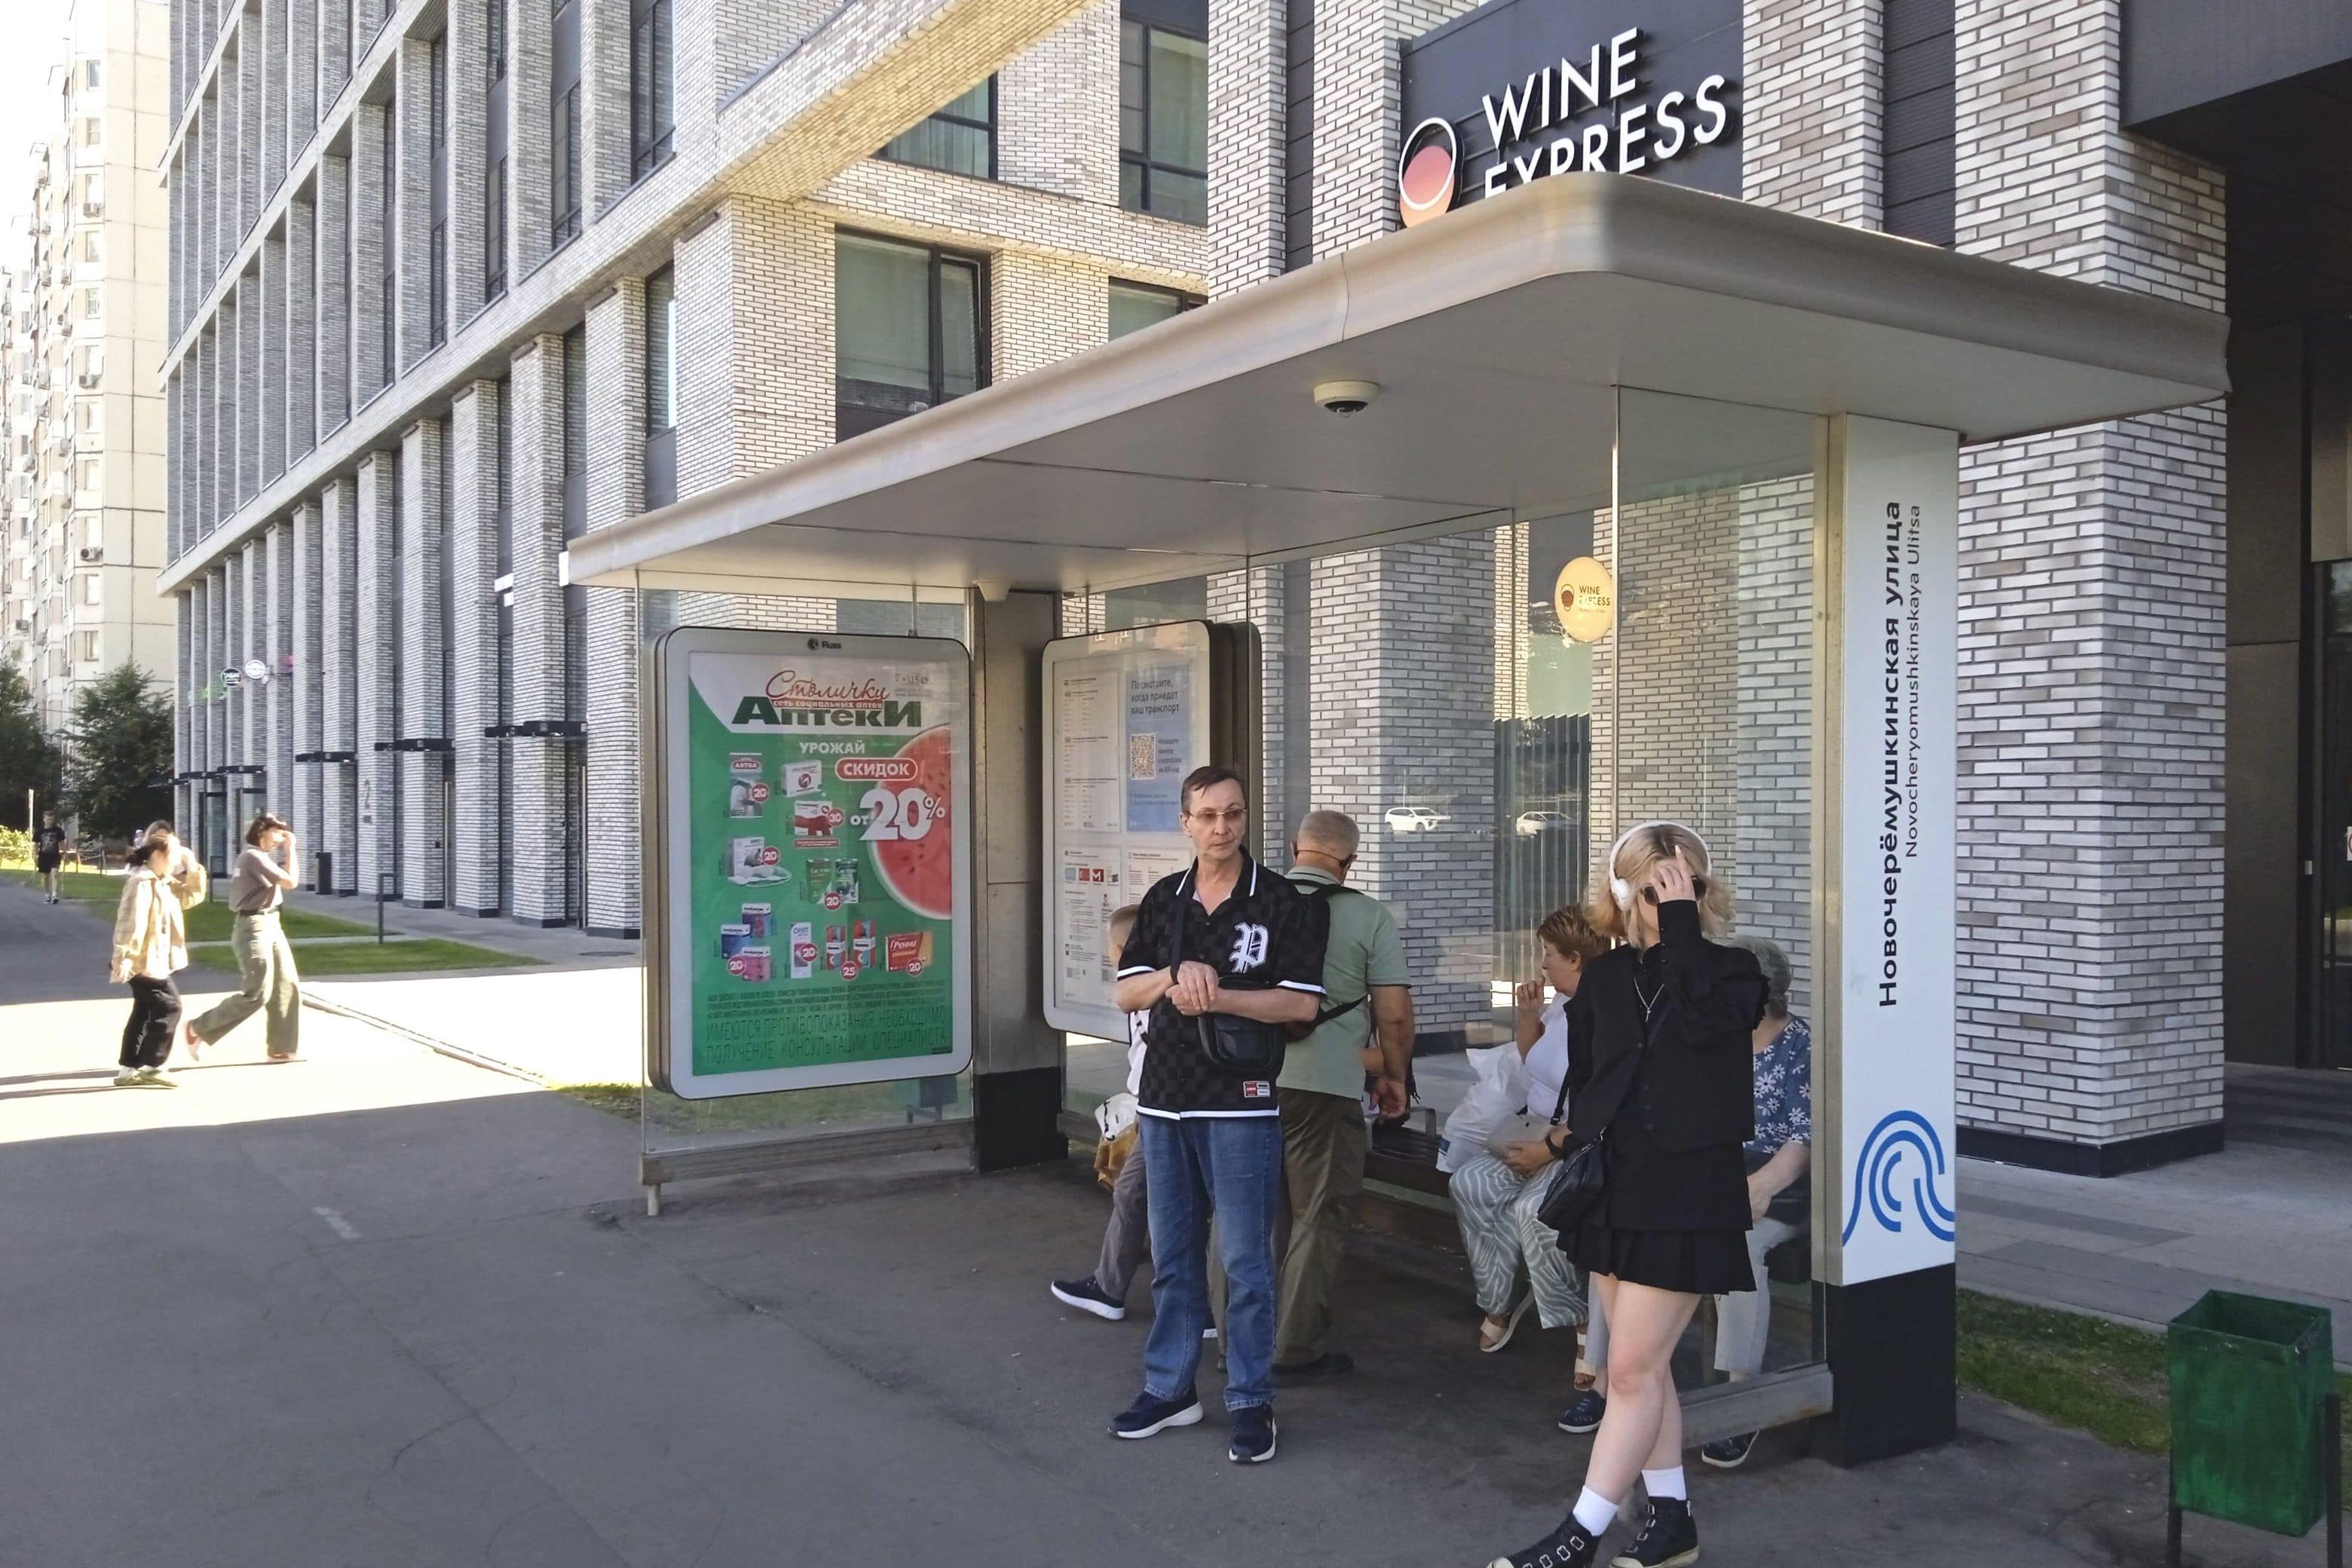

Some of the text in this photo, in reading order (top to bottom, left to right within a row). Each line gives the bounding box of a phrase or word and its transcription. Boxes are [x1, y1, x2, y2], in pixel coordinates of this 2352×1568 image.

[1482, 26, 1639, 150] WINE
[1579, 585, 1600, 595] WINE
[765, 669, 890, 701] Столички
[1905, 506, 1922, 858] Novocheryomushkinskaya Ulitsa
[795, 700, 854, 709] социальных
[1145, 703, 1180, 715] транспорт
[799, 740, 865, 755] УРОЖАЙ
[1879, 501, 1903, 1008] Новочерёмушкинская улица
[843, 763, 910, 778] СКИДОК
[850, 814, 869, 825] от
